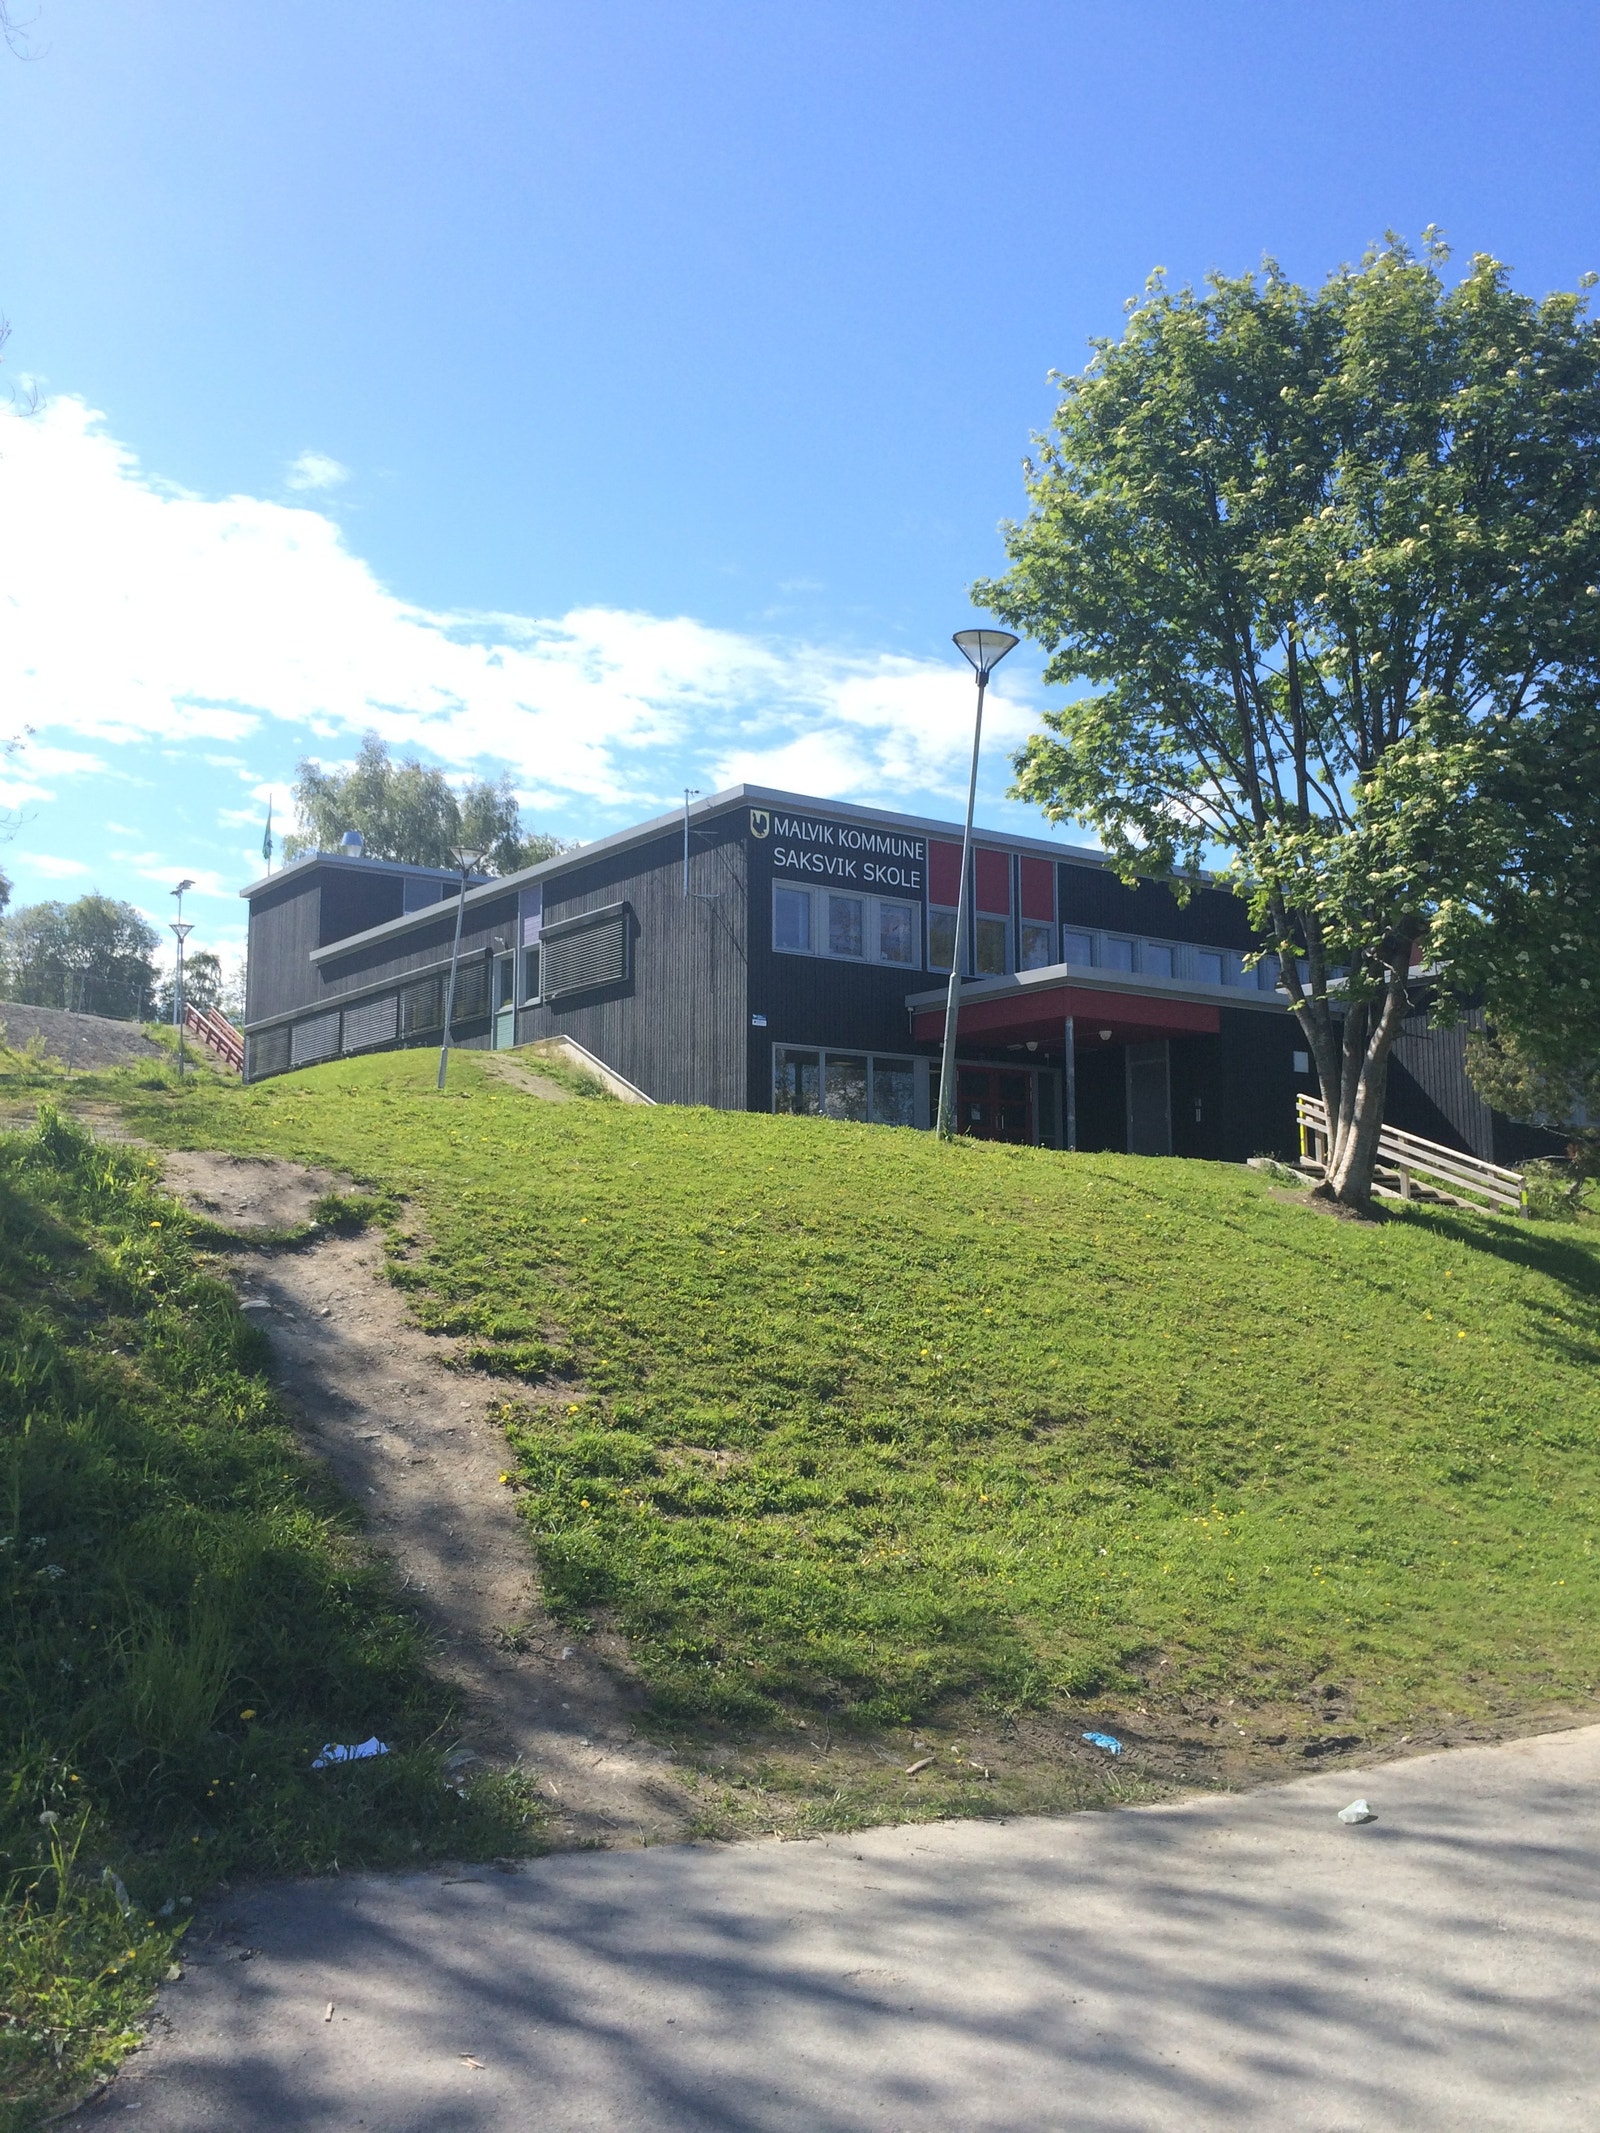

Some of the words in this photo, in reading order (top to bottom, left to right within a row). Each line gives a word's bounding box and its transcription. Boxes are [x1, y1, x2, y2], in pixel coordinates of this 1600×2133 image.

[774, 816, 834, 845] MALVIK
[838, 828, 924, 861] KOMMUNE
[773, 847, 857, 879] SAKSVIK
[863, 862, 921, 889] SKOLE
